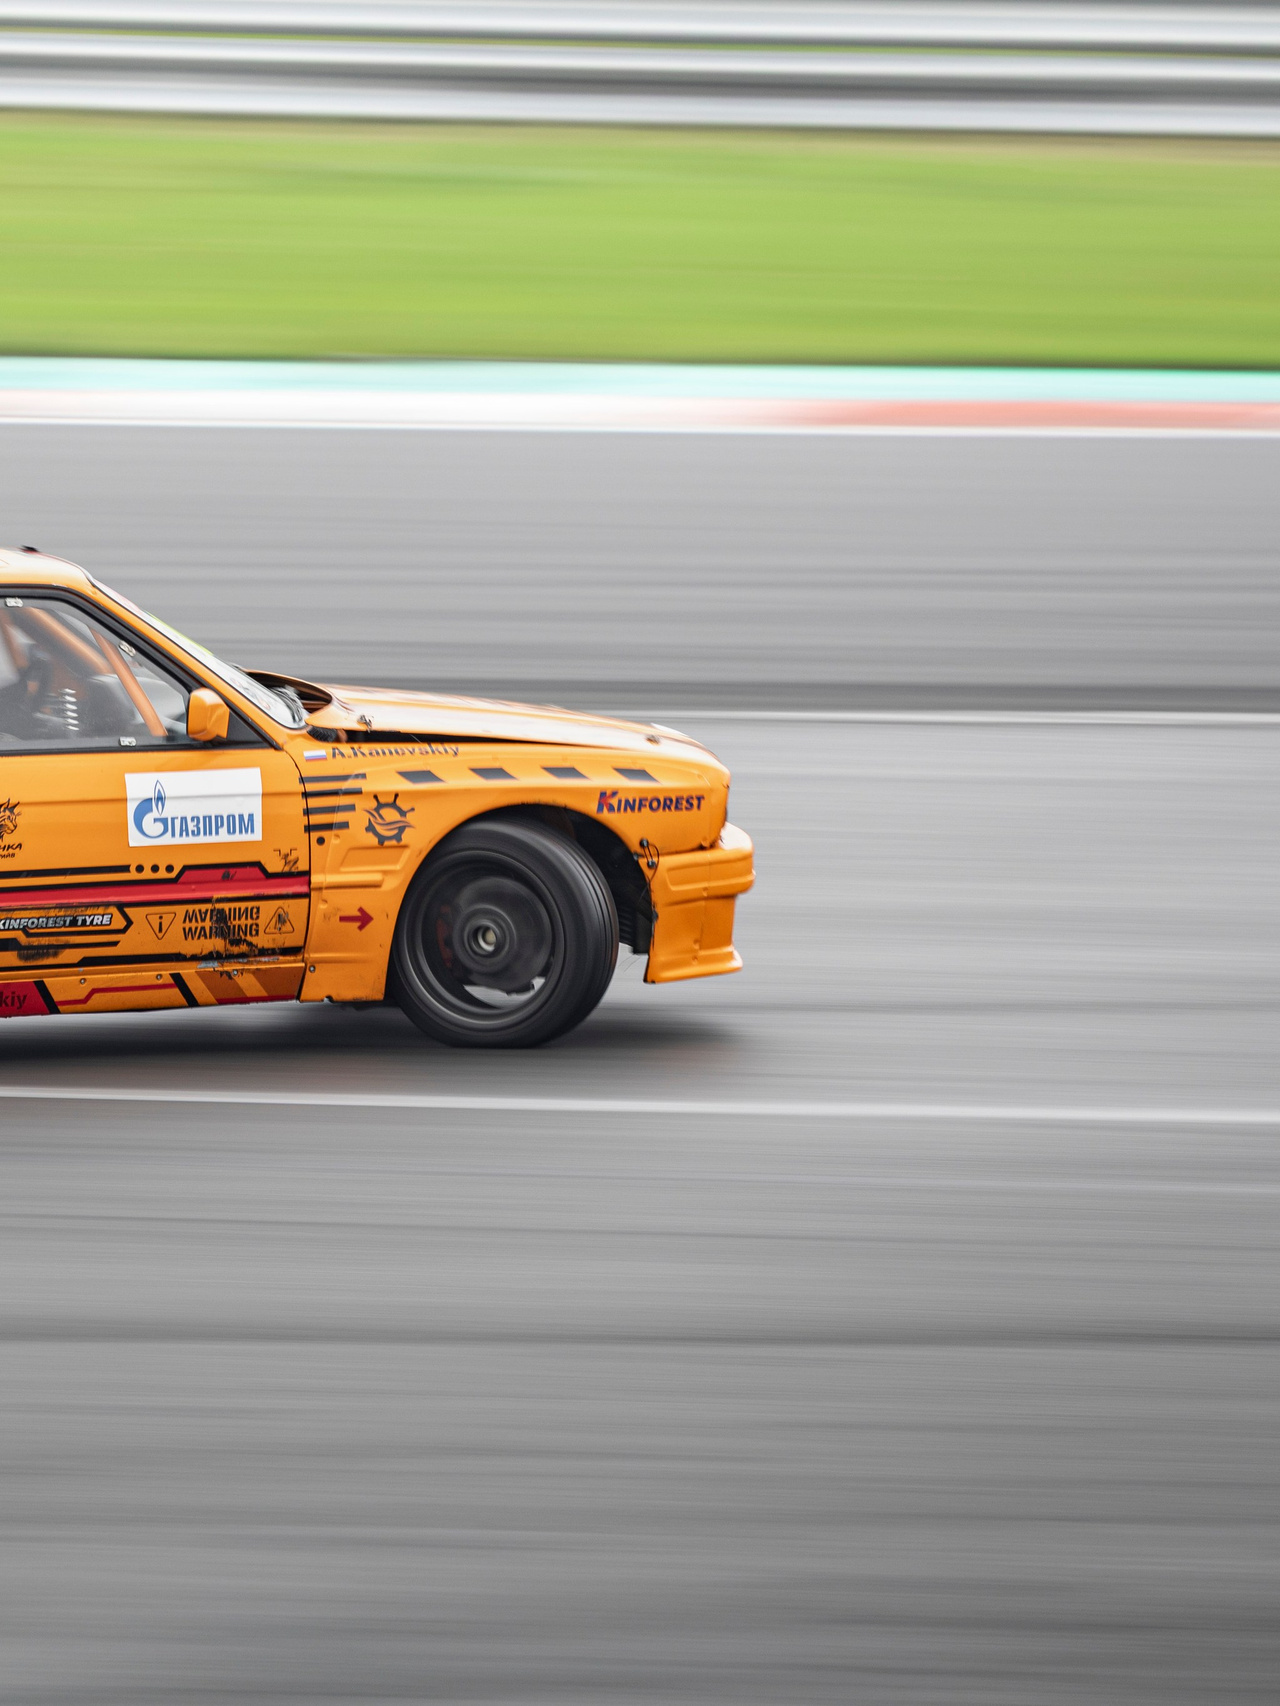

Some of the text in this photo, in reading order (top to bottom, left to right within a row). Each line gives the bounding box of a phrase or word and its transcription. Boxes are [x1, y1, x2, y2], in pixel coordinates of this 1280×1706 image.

[596, 790, 705, 814] KINFOREST
[170, 813, 255, 838] ГАЗПРОМ
[75, 914, 112, 926] TYRE
[182, 923, 260, 941] WARNING
